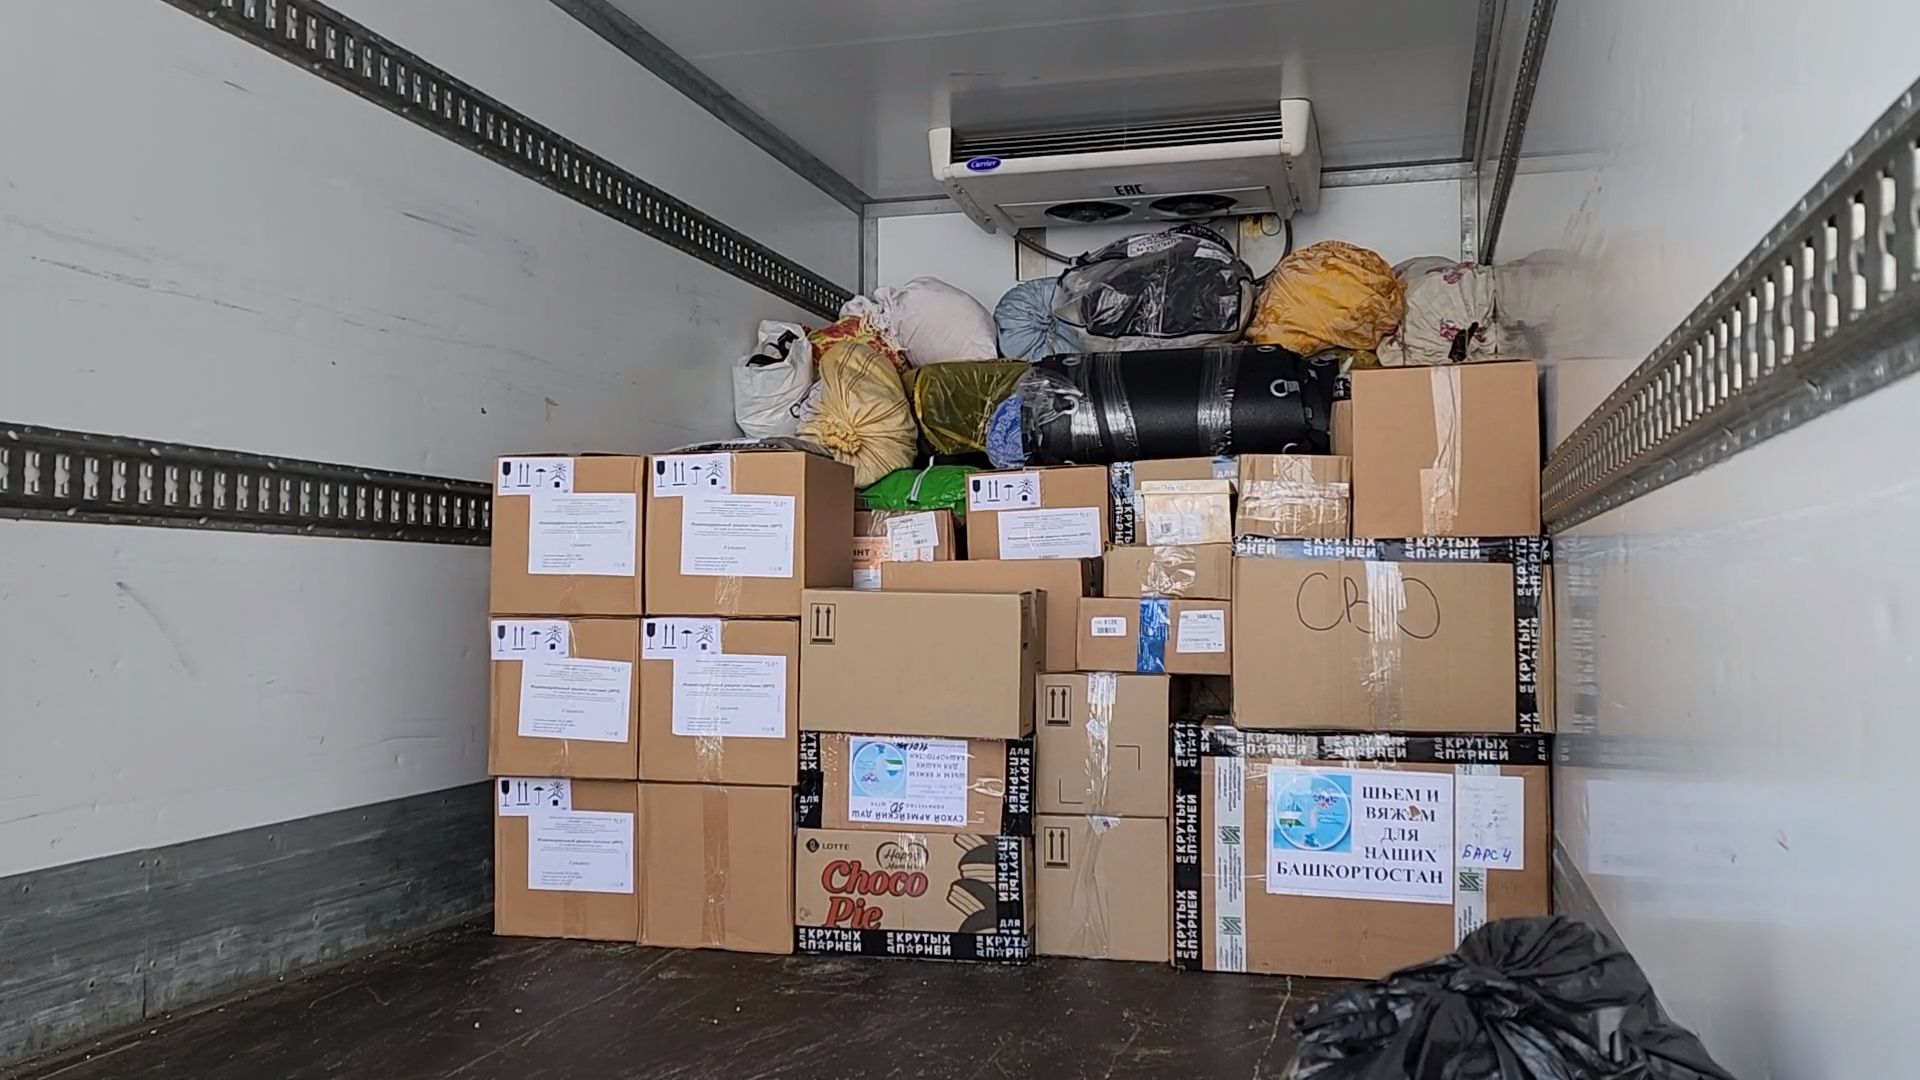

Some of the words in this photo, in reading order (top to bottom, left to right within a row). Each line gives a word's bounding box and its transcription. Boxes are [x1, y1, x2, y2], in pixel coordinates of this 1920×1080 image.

[970, 160, 997, 169] Carrier
[1416, 537, 1480, 548] КРУТЫХ
[1518, 618, 1531, 682] КРУТЫХ
[1445, 738, 1509, 750] КРУТЫХ
[1019, 756, 1030, 814] КРУТЫХ
[1361, 785, 1421, 802] ШЬЕМ
[1426, 789, 1440, 803] И
[851, 809, 872, 819] ДУШ
[876, 811, 931, 822] АРМЕЙСКИЙ
[934, 813, 964, 823] СУХОЙ
[1175, 794, 1187, 854] КРУТЫХ
[1380, 827, 1420, 843] ДЛЯ
[821, 843, 850, 851] LOTTE
[1364, 846, 1438, 864] НАШИХ
[1461, 843, 1500, 862] БАРС
[821, 859, 929, 898] Choco
[1009, 840, 1020, 902] КРУТЫХ
[1276, 860, 1444, 885] БАШКОРТОСТАН
[821, 895, 884, 930] Pie
[1175, 889, 1187, 949] КРУТЫХ
[807, 928, 862, 942] КРУТЫХ
[896, 932, 951, 946] КРУТЫХ
